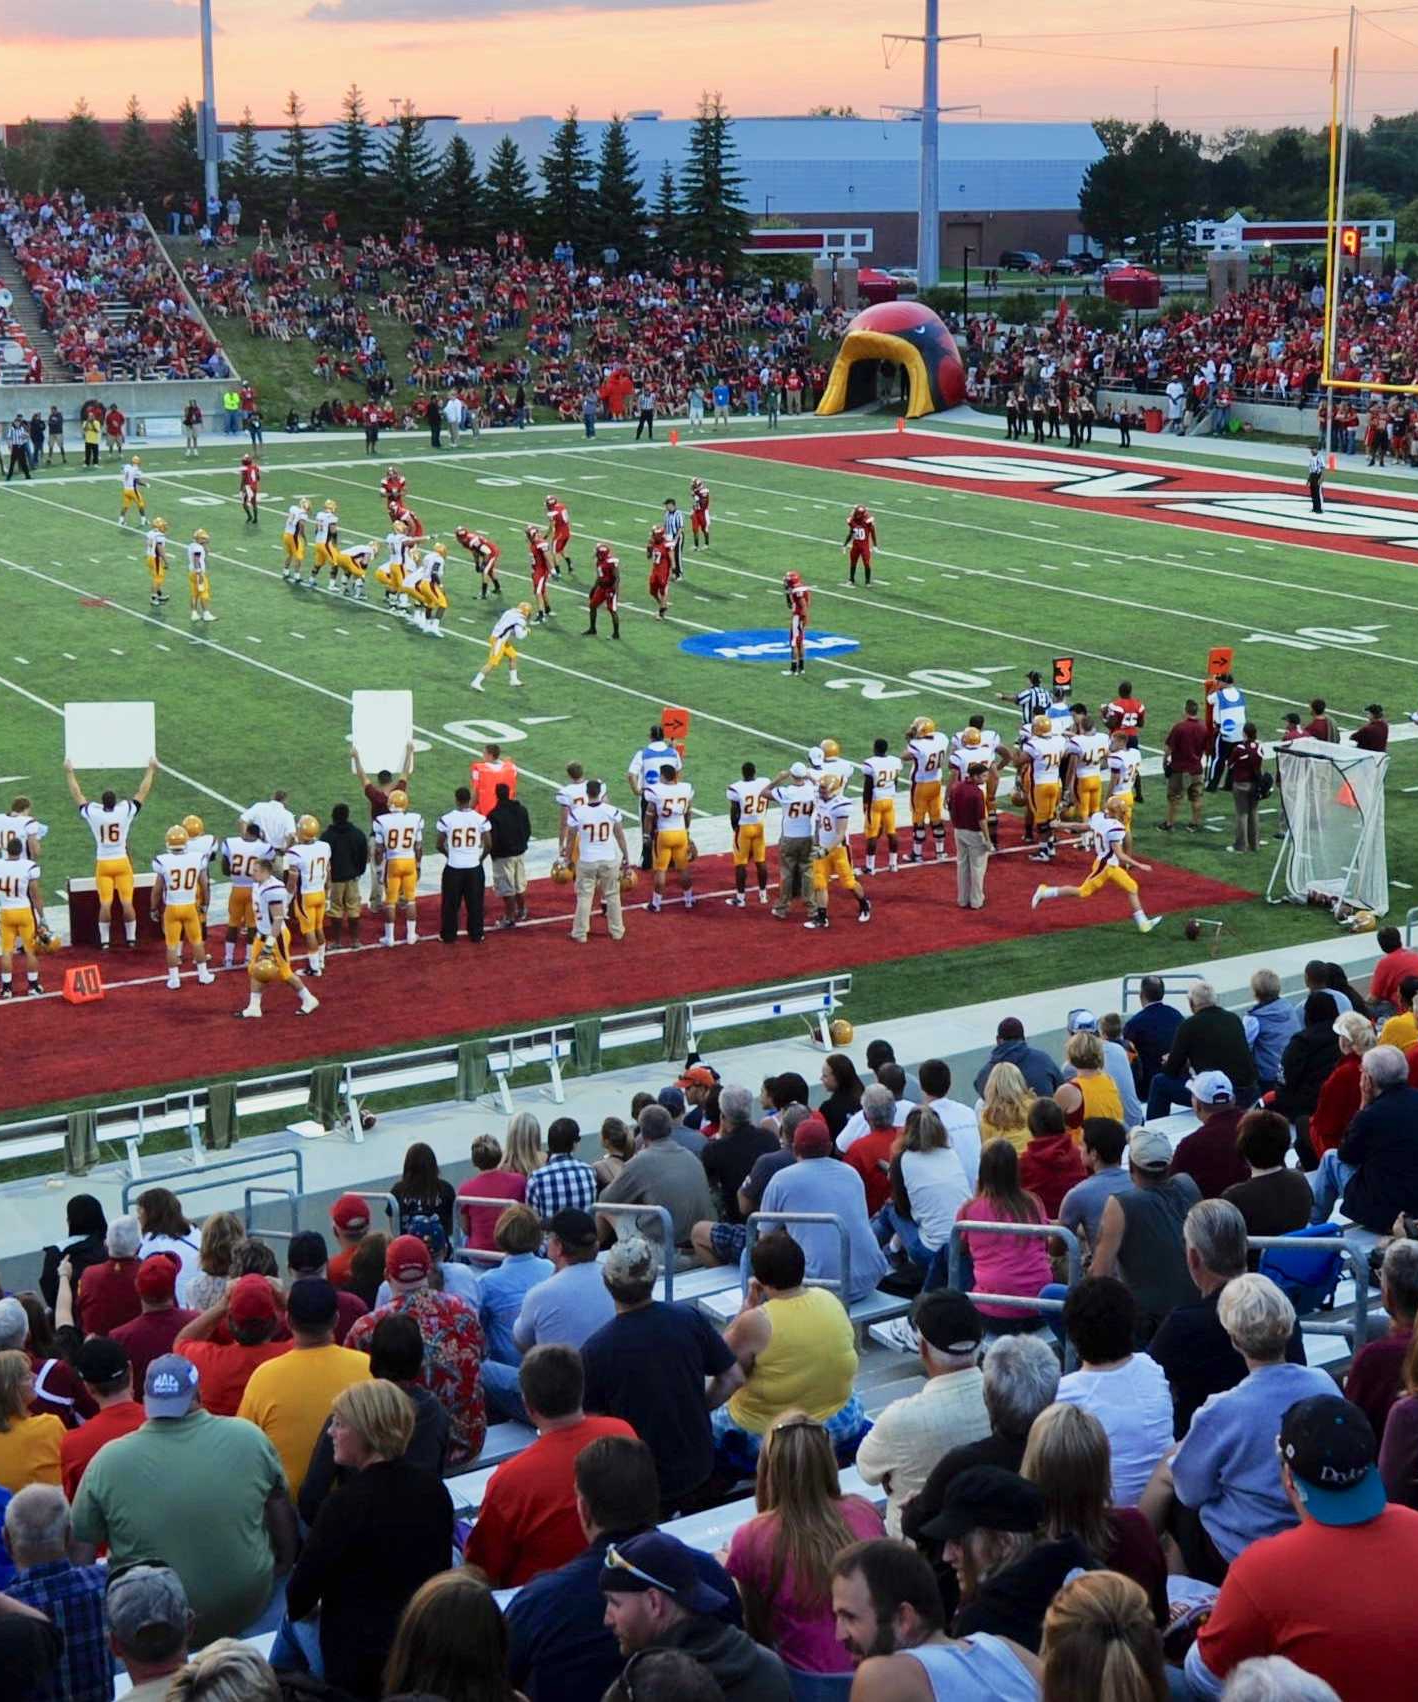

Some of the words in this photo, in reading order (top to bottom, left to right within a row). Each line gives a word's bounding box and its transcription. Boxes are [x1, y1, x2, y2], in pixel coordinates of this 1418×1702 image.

[1343, 230, 1357, 254] 9
[1240, 628, 1379, 650] 10
[1055, 660, 1071, 684] 3
[825, 668, 994, 701] 20
[100, 823, 120, 843] 16
[388, 827, 414, 850] 85
[451, 827, 476, 848] 66
[583, 822, 610, 843] 70
[169, 868, 197, 892] 30
[309, 857, 327, 882] 17
[73, 967, 102, 996] 40
